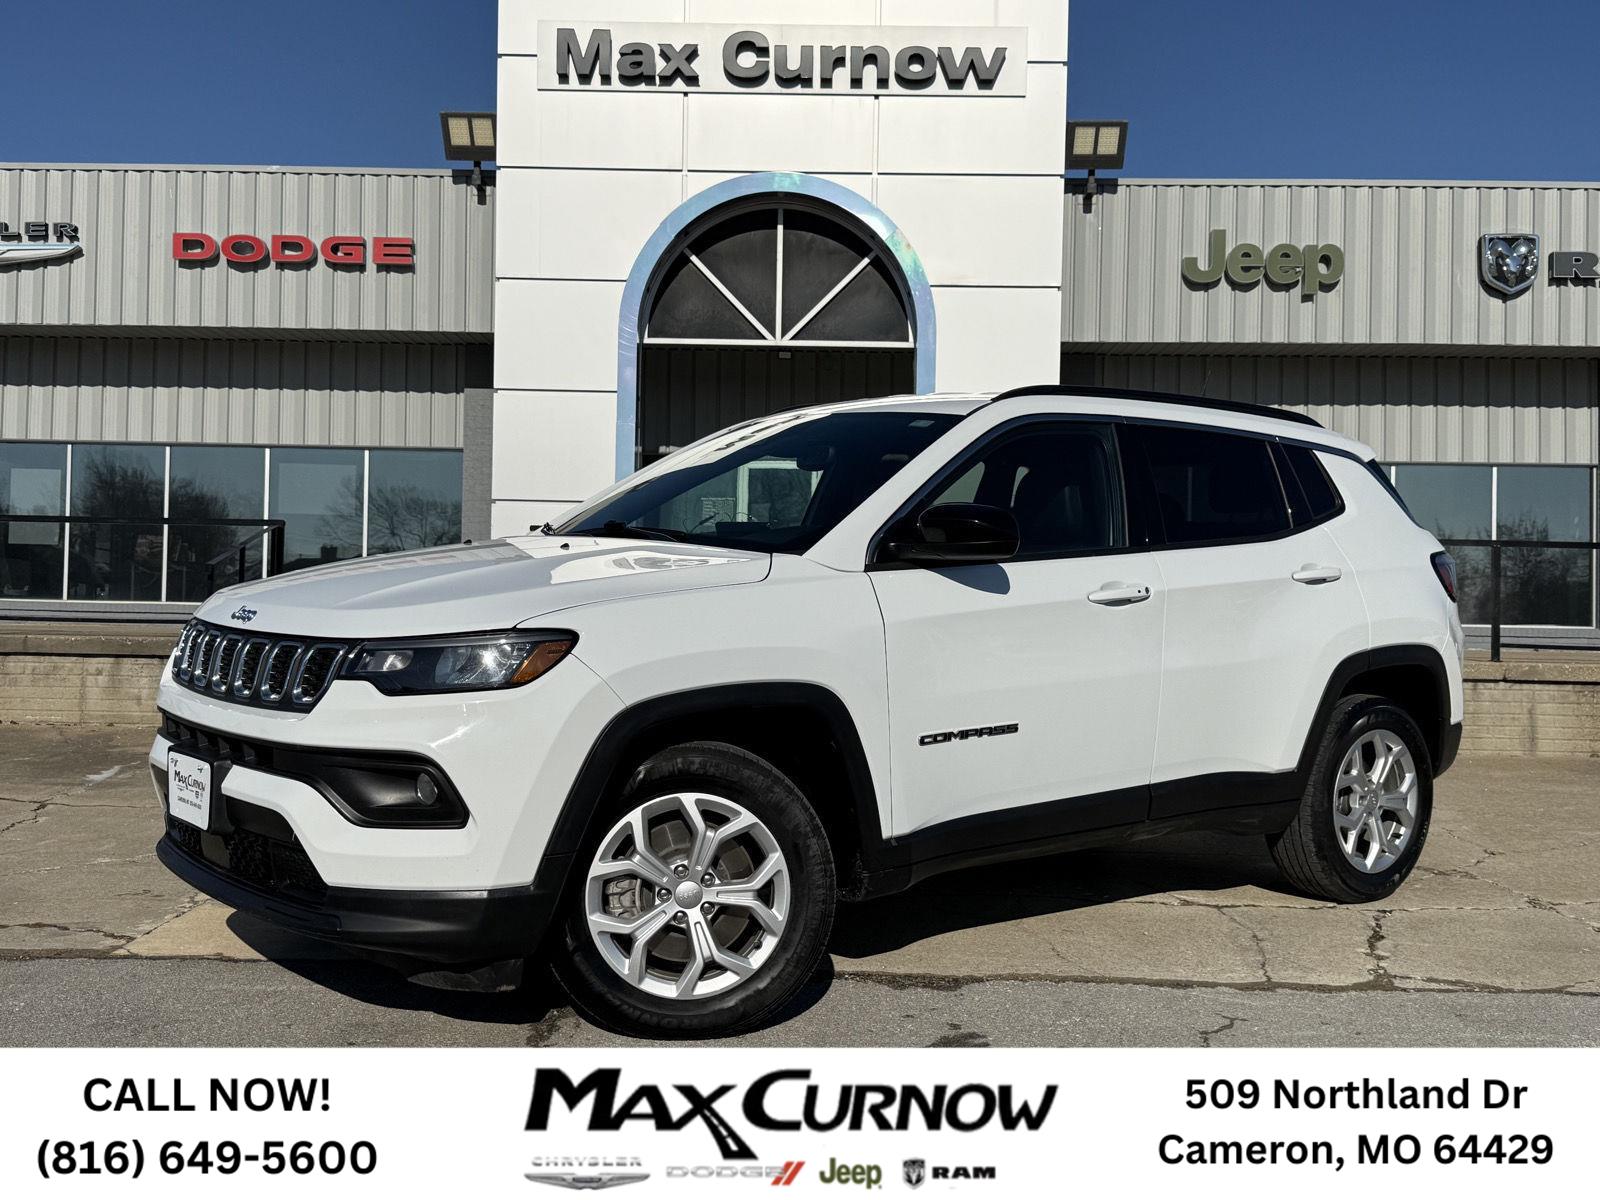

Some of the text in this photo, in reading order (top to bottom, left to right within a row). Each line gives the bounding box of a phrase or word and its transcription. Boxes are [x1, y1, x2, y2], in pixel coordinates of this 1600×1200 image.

[556, 28, 1008, 91] Max Curnow
[172, 232, 416, 274] DODGE
[1181, 229, 1345, 304] Jeep
[919, 722, 1019, 746] COMPASS
